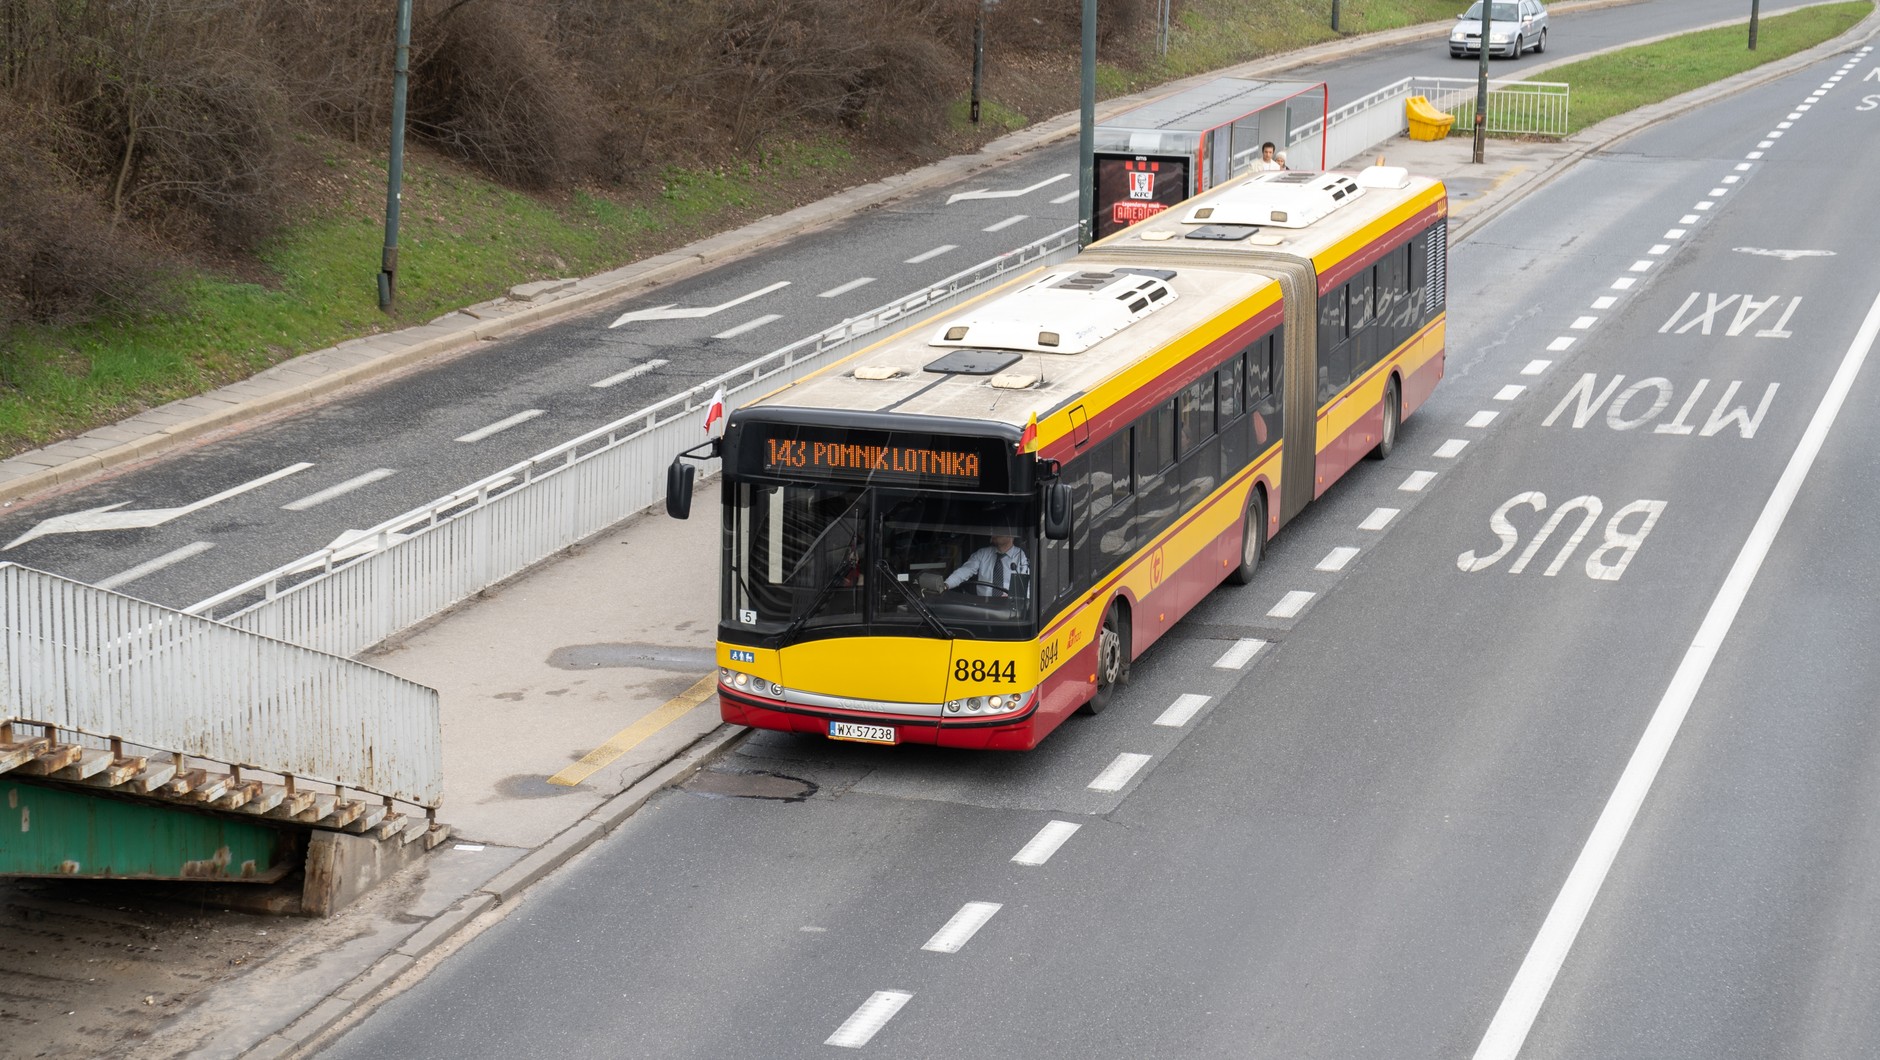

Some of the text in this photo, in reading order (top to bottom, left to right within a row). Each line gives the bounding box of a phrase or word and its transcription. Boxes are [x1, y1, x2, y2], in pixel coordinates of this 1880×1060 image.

[1117, 206, 1164, 220] AMERIC
[1657, 291, 1803, 338] TAXI
[1541, 372, 1780, 439] MTON
[767, 438, 978, 477] 143 POMNIK LOTNIKA
[1457, 490, 1668, 581] BUS
[745, 612, 752, 623] 5
[954, 658, 1017, 684] 8844
[1040, 638, 1059, 672] 8844
[837, 724, 892, 740] WX 57238
